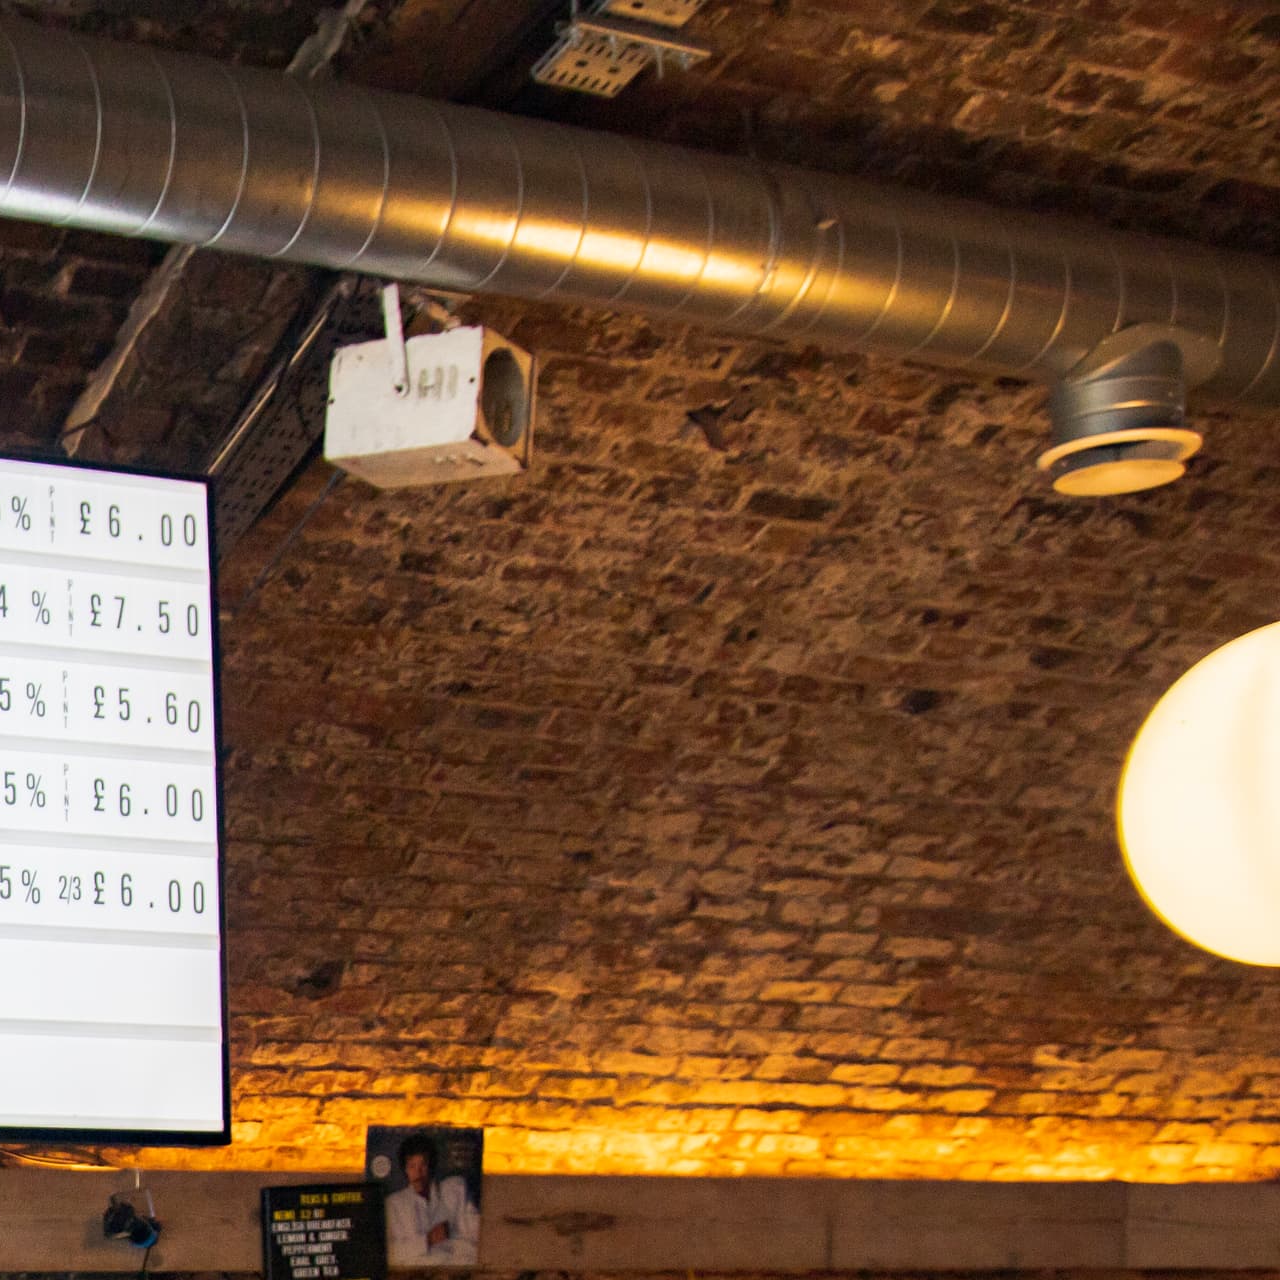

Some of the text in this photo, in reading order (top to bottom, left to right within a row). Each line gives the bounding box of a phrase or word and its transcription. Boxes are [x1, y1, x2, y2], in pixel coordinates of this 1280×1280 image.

[80, 501, 196, 547] £6.00
[91, 594, 198, 636] £7.50
[94, 686, 200, 733] £5.60
[94, 778, 203, 822] £6.00
[59, 876, 81, 904] 2/3
[94, 871, 204, 914] £6.00
